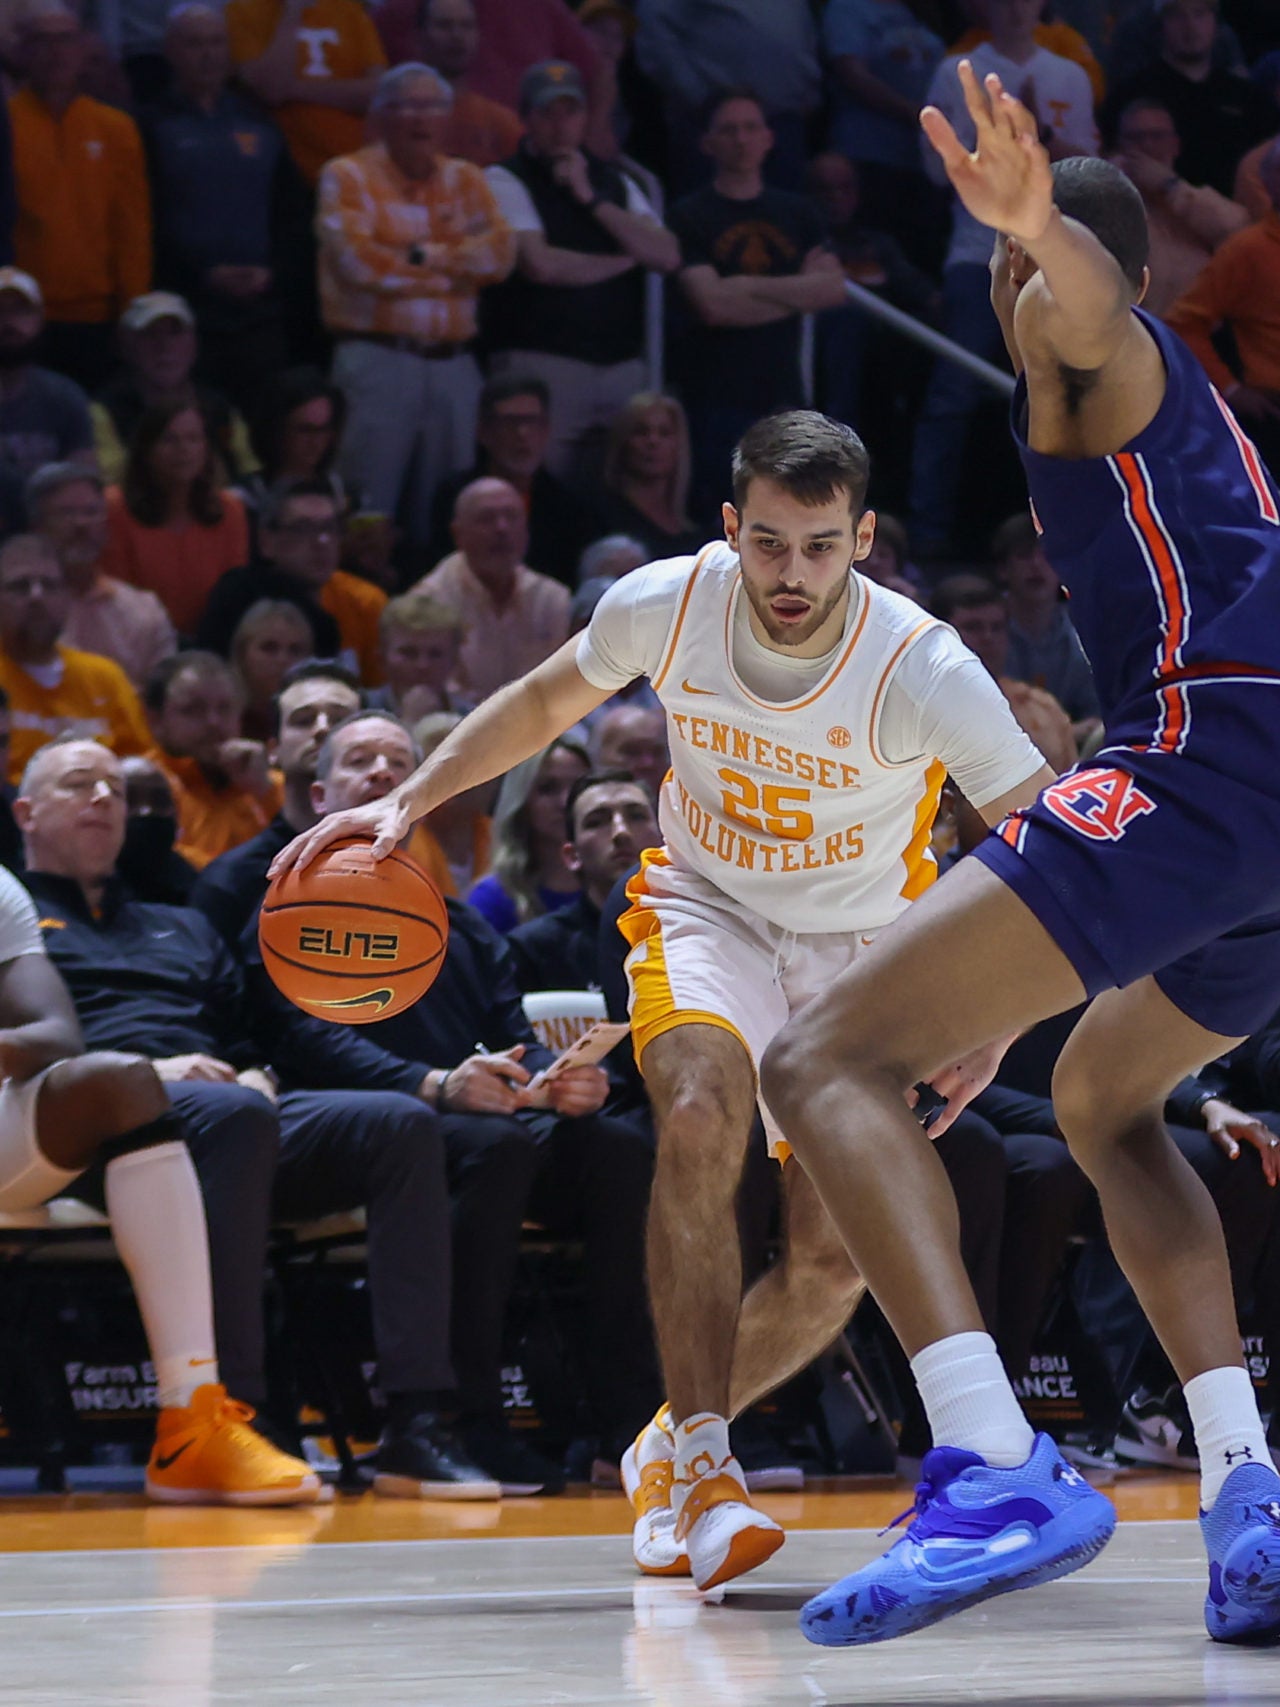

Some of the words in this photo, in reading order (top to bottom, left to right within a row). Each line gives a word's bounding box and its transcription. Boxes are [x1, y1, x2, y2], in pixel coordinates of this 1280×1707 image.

[296, 28, 340, 76] T
[672, 712, 862, 790] TENNESSEE
[828, 727, 851, 748] SEC
[677, 776, 865, 873] VOLUNTEERS
[717, 766, 814, 842] 25
[298, 926, 399, 961] ELITE
